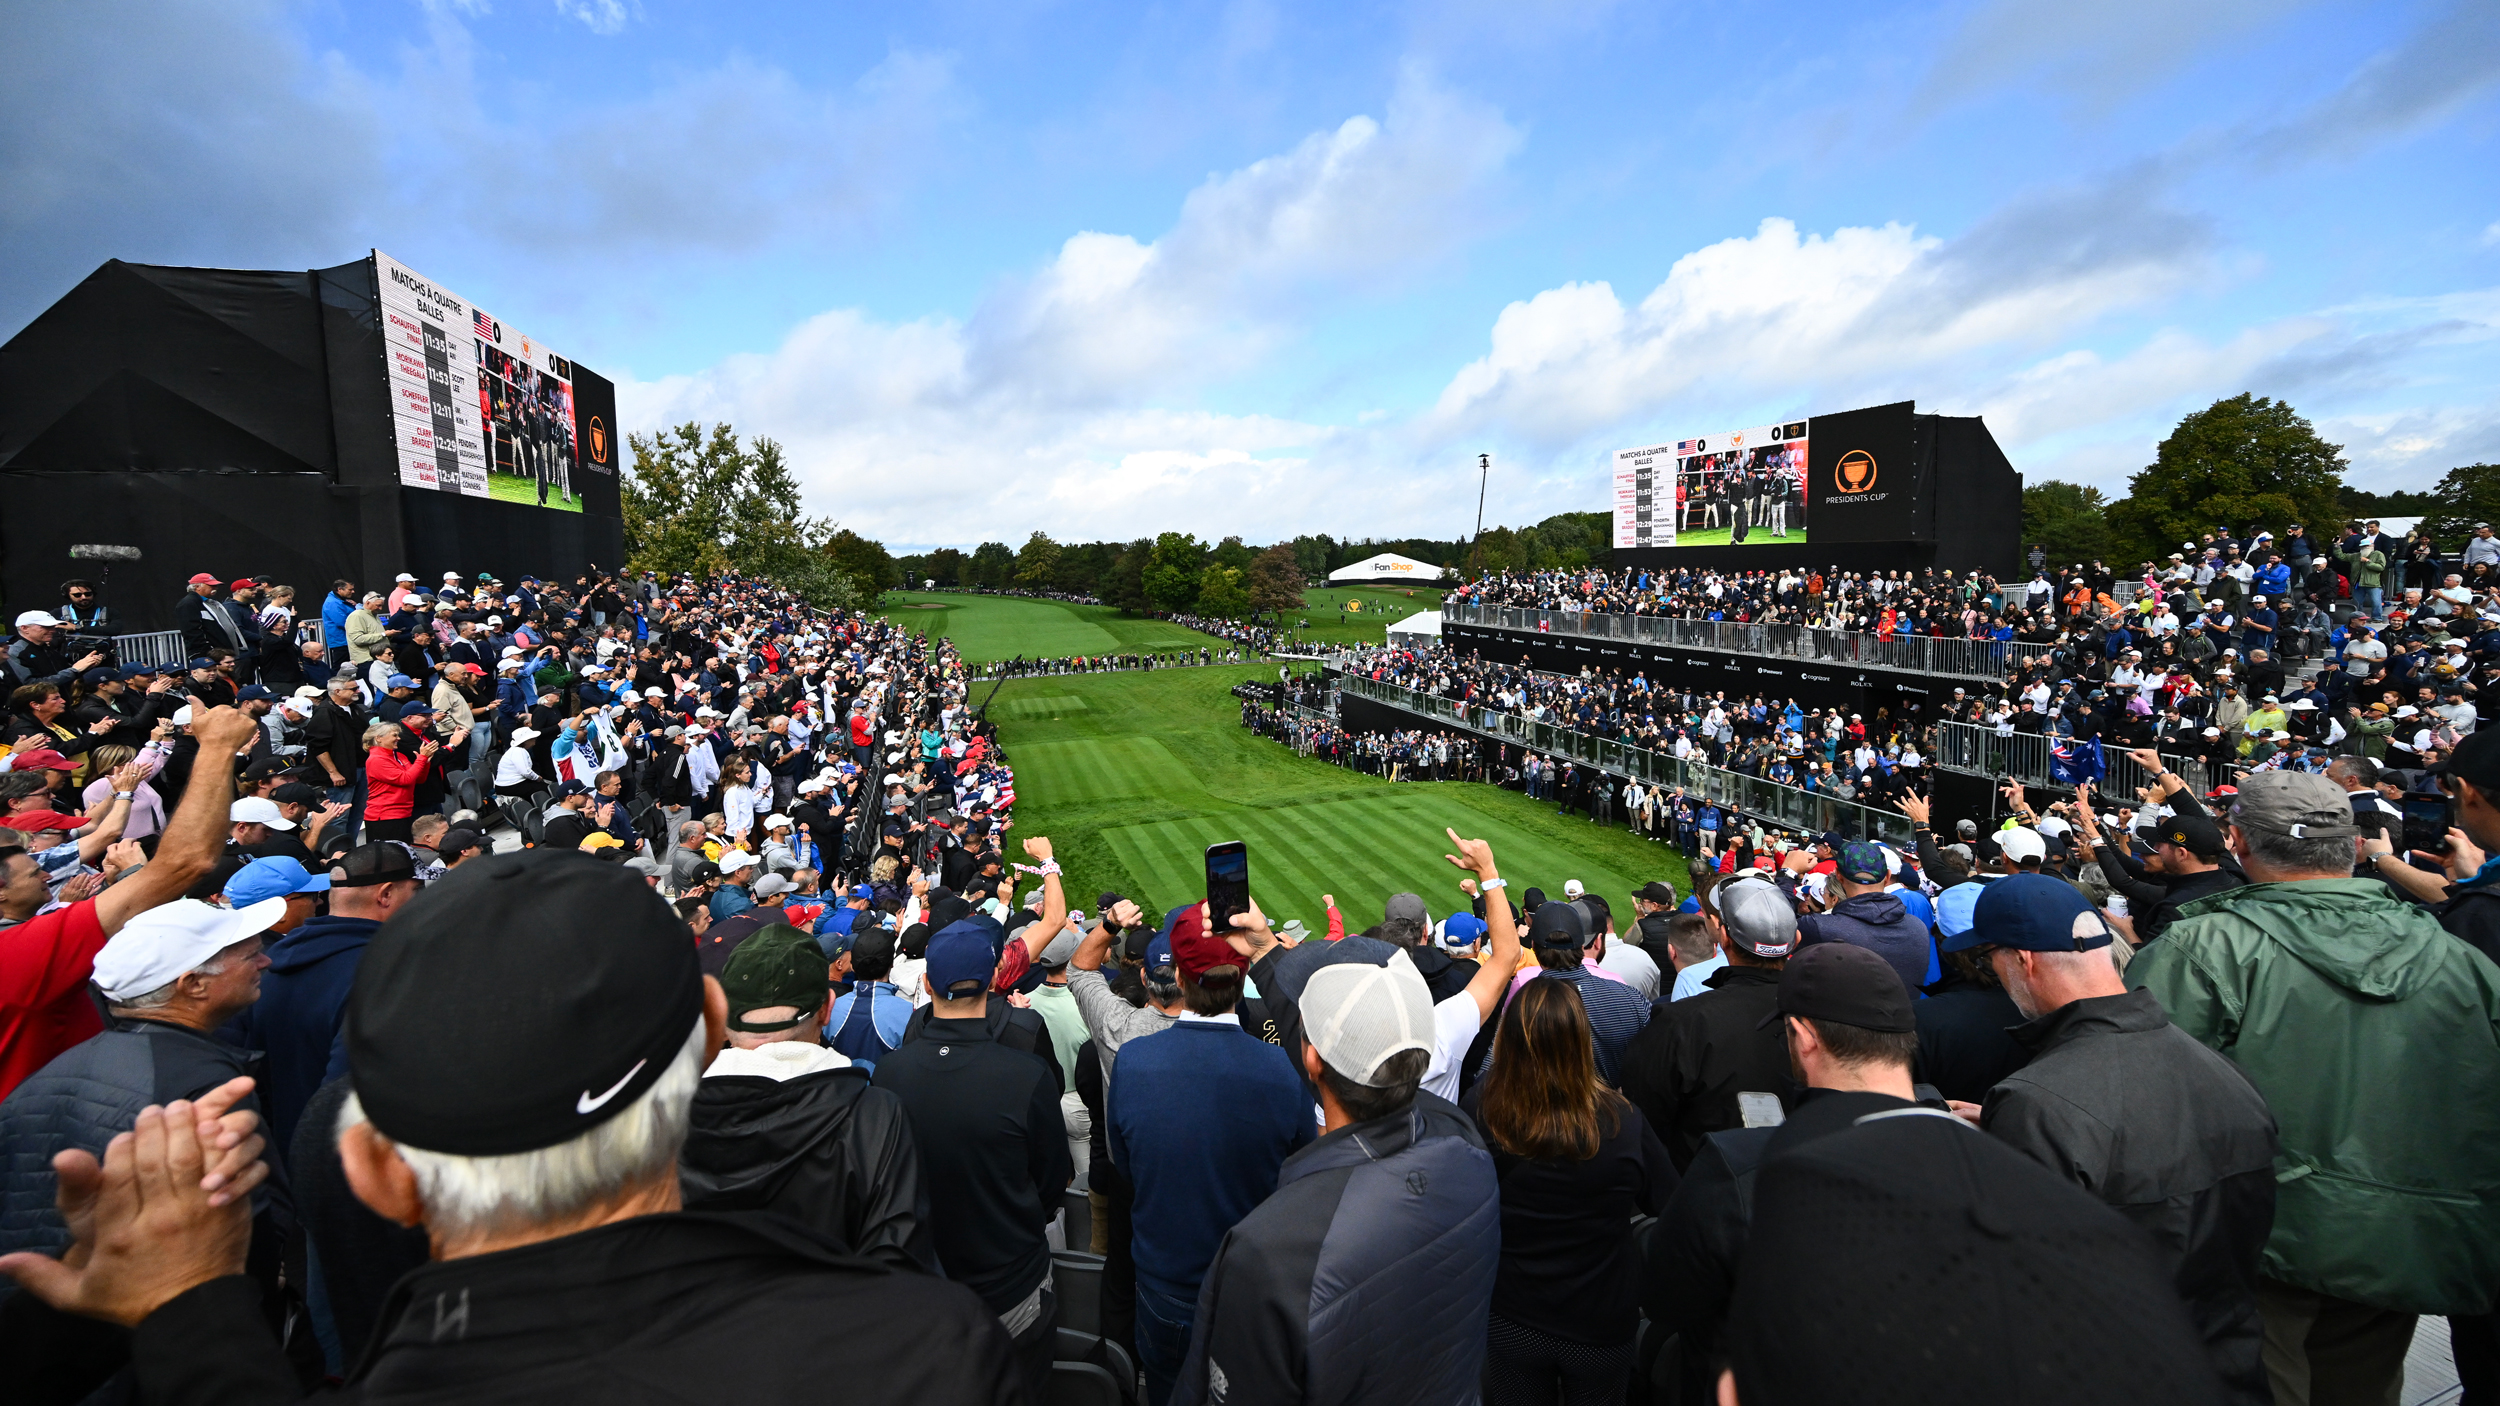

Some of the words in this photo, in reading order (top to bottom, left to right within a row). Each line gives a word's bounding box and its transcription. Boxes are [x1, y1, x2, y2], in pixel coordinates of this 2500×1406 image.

[391, 267, 426, 297] MATCHS
[434, 291, 462, 316] QUATRE
[417, 299, 444, 322] BALLES
[424, 332, 446, 352] 11:35
[428, 366, 449, 386] 11:53
[432, 401, 452, 419] 12:11
[1772, 426, 1781, 440] 0
[434, 436, 457, 452] 12:29
[1698, 439, 1706, 452] 0
[1620, 450, 1642, 460] MATCHS
[1646, 446, 1668, 456] QUATRE
[438, 469, 460, 484] 12:47
[1826, 494, 1868, 504] PRESIDENTS
[1870, 493, 1886, 501] CUP
[1374, 563, 1390, 571] Fan
[1391, 562, 1413, 572] Shop
